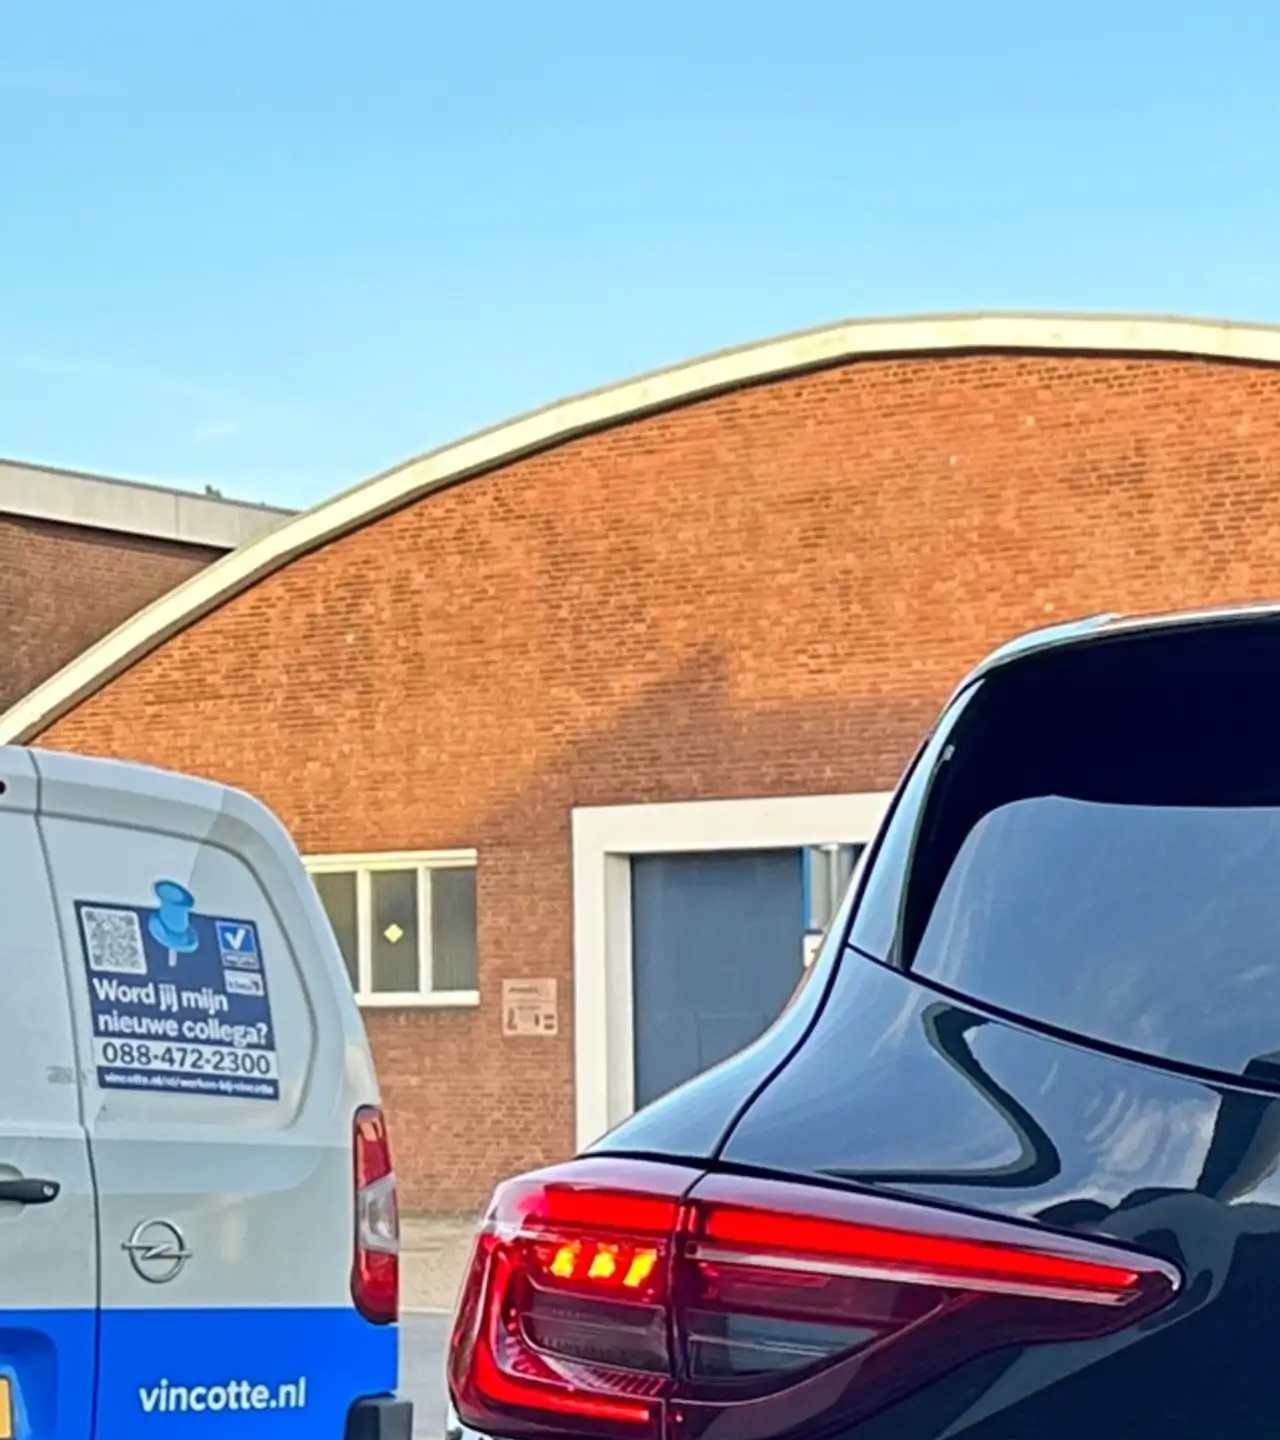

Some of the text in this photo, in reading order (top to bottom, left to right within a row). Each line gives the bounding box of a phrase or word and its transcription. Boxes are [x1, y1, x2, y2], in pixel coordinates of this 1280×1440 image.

[92, 977, 229, 1016] Word jij mijn
[97, 1010, 268, 1048] nieuwe collega?
[102, 1041, 271, 1076] 088-472-2300
[138, 1376, 307, 1413] vincotte.nl
